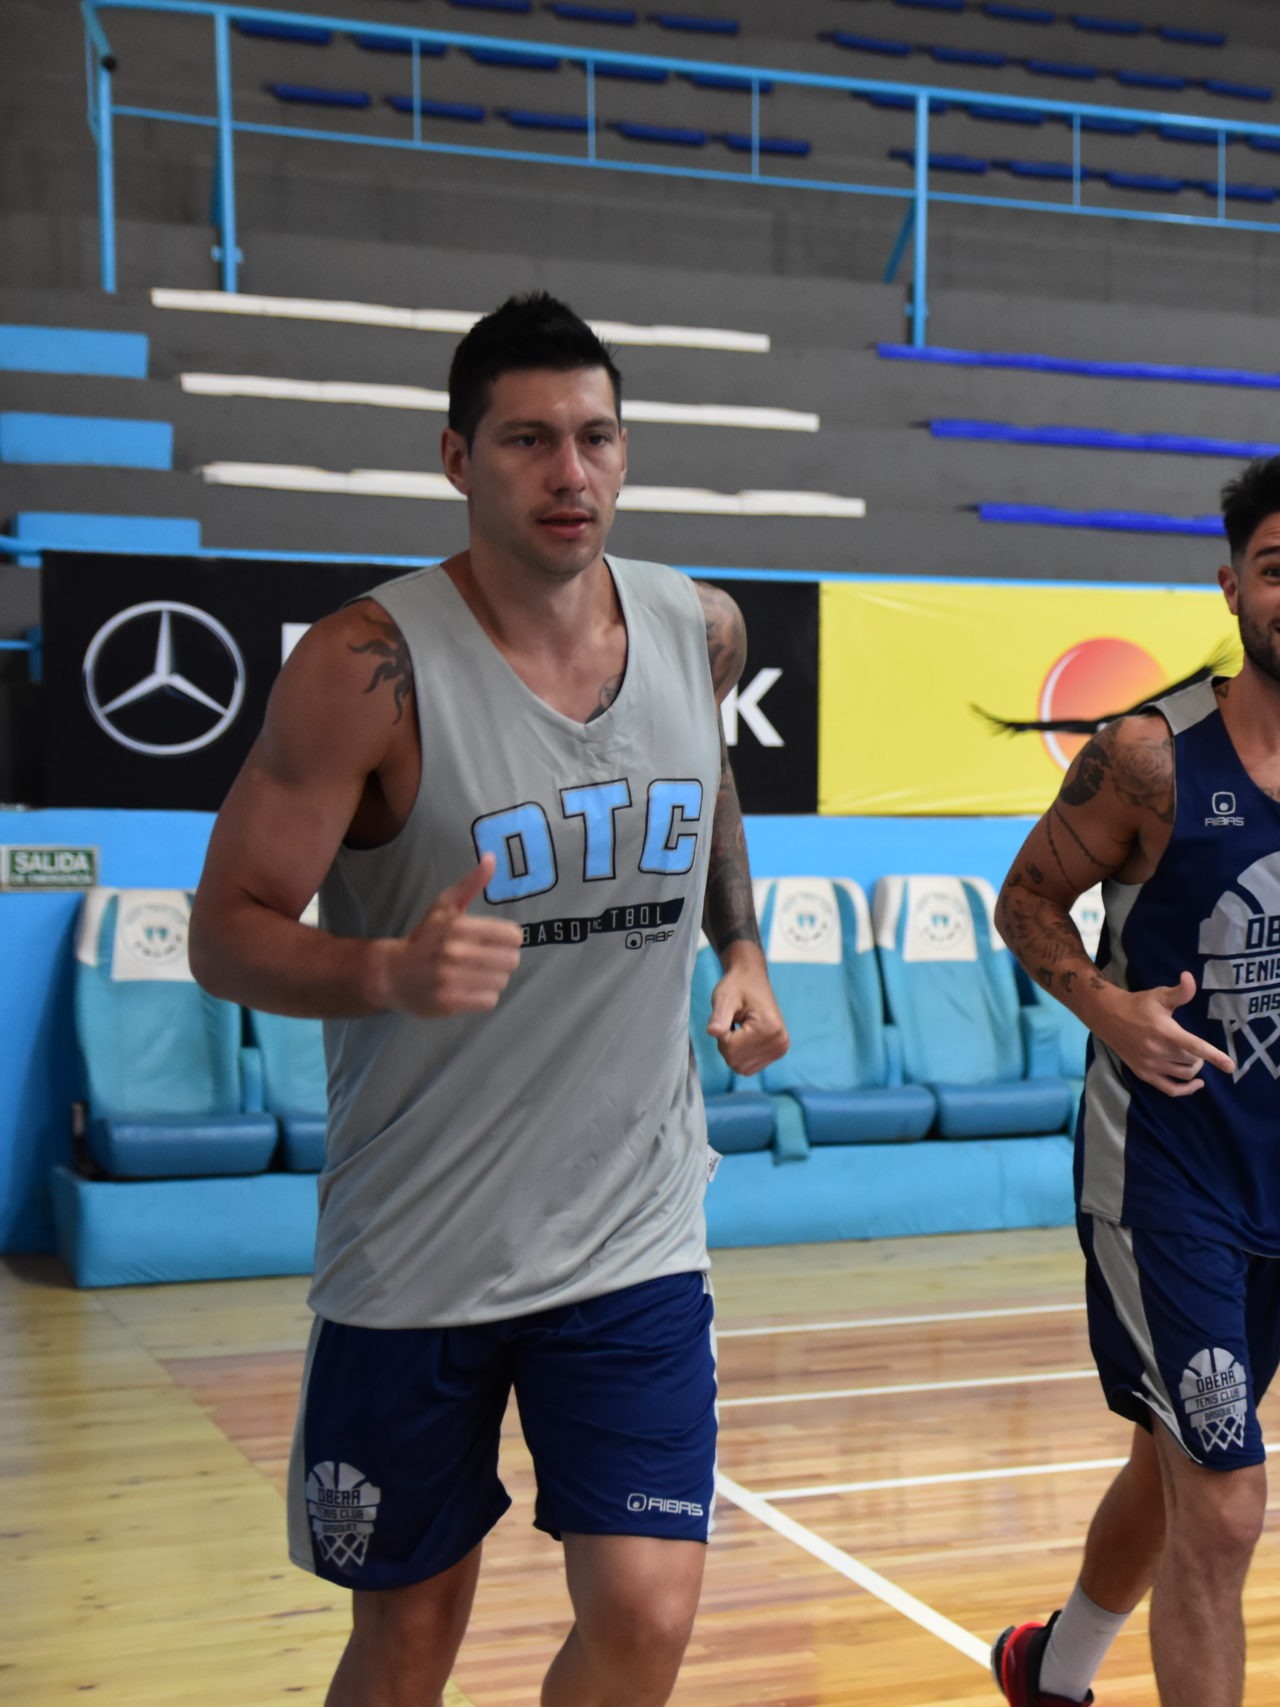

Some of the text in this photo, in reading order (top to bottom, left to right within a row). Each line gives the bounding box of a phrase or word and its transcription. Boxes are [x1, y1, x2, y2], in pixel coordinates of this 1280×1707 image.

[471, 777, 704, 906] OTC
[14, 851, 90, 873] SALIDA
[647, 1497, 704, 1517] RIBAS
